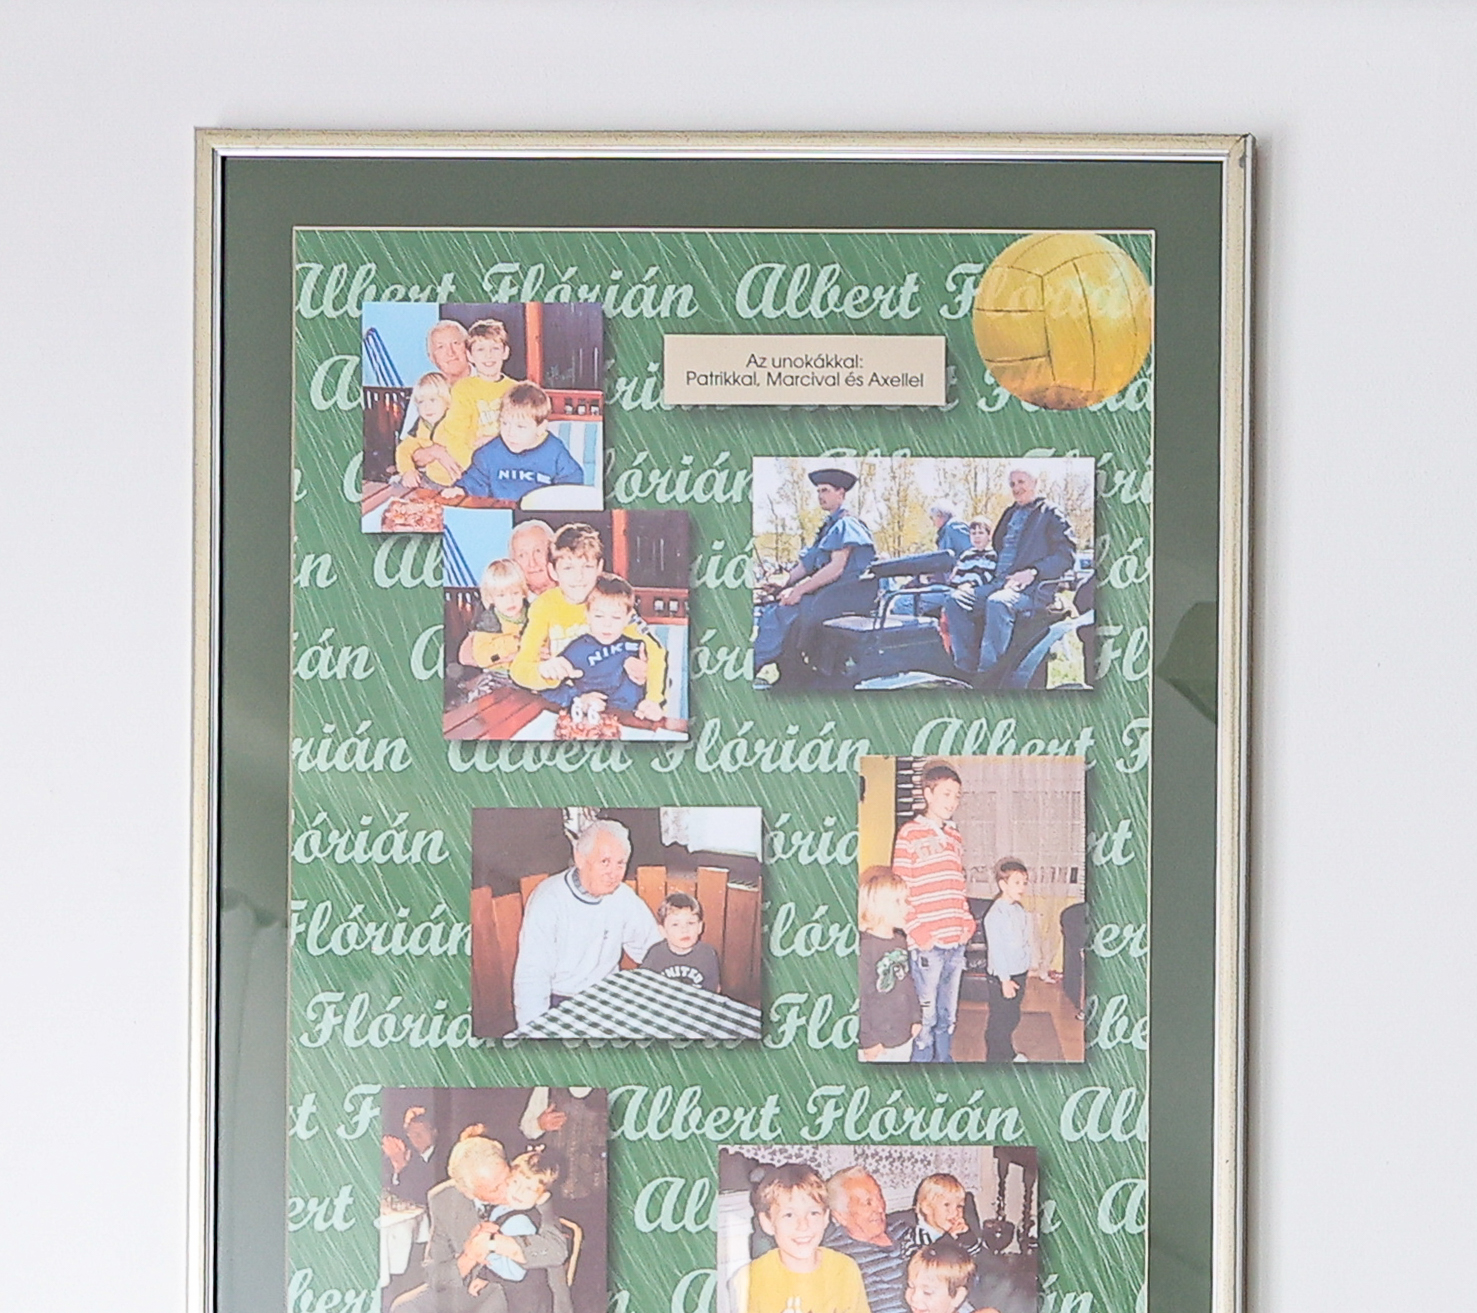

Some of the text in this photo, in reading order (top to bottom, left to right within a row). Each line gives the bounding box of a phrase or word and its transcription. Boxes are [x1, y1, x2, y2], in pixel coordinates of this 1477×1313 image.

[736, 263, 922, 320] Albert
[746, 352, 863, 368] Az unokákkal:
[686, 371, 924, 388] Patrikkal, Marcival és Axellel
[499, 469, 551, 484] NIKE
[589, 640, 639, 667] NIKE
[609, 1085, 1022, 1143] Albert Flórián
